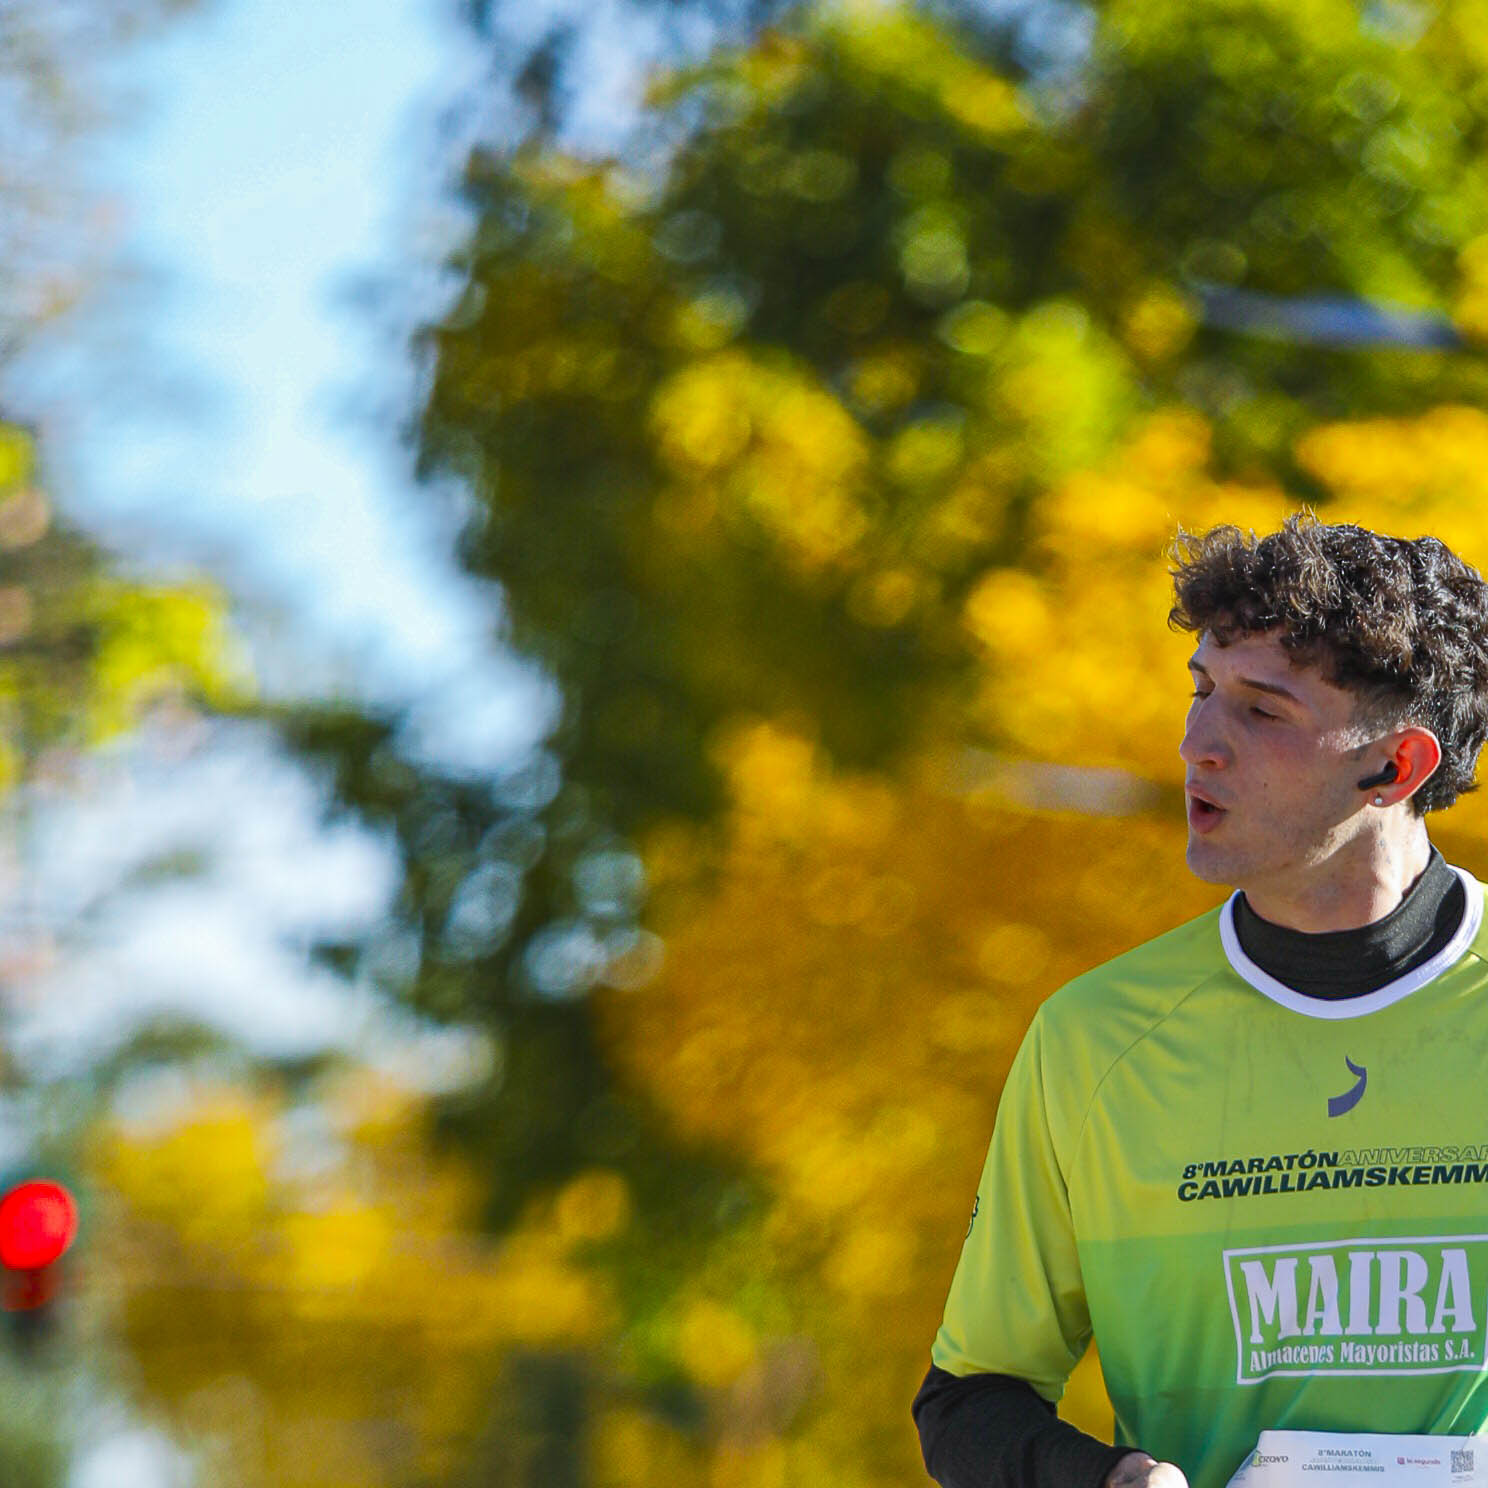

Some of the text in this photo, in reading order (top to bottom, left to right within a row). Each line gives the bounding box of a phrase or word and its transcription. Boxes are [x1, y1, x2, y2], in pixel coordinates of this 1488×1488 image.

[1240, 1248, 1477, 1344] MAIRA
[1340, 1341, 1439, 1366] Mayoristas
[1445, 1338, 1475, 1361] S.A.
